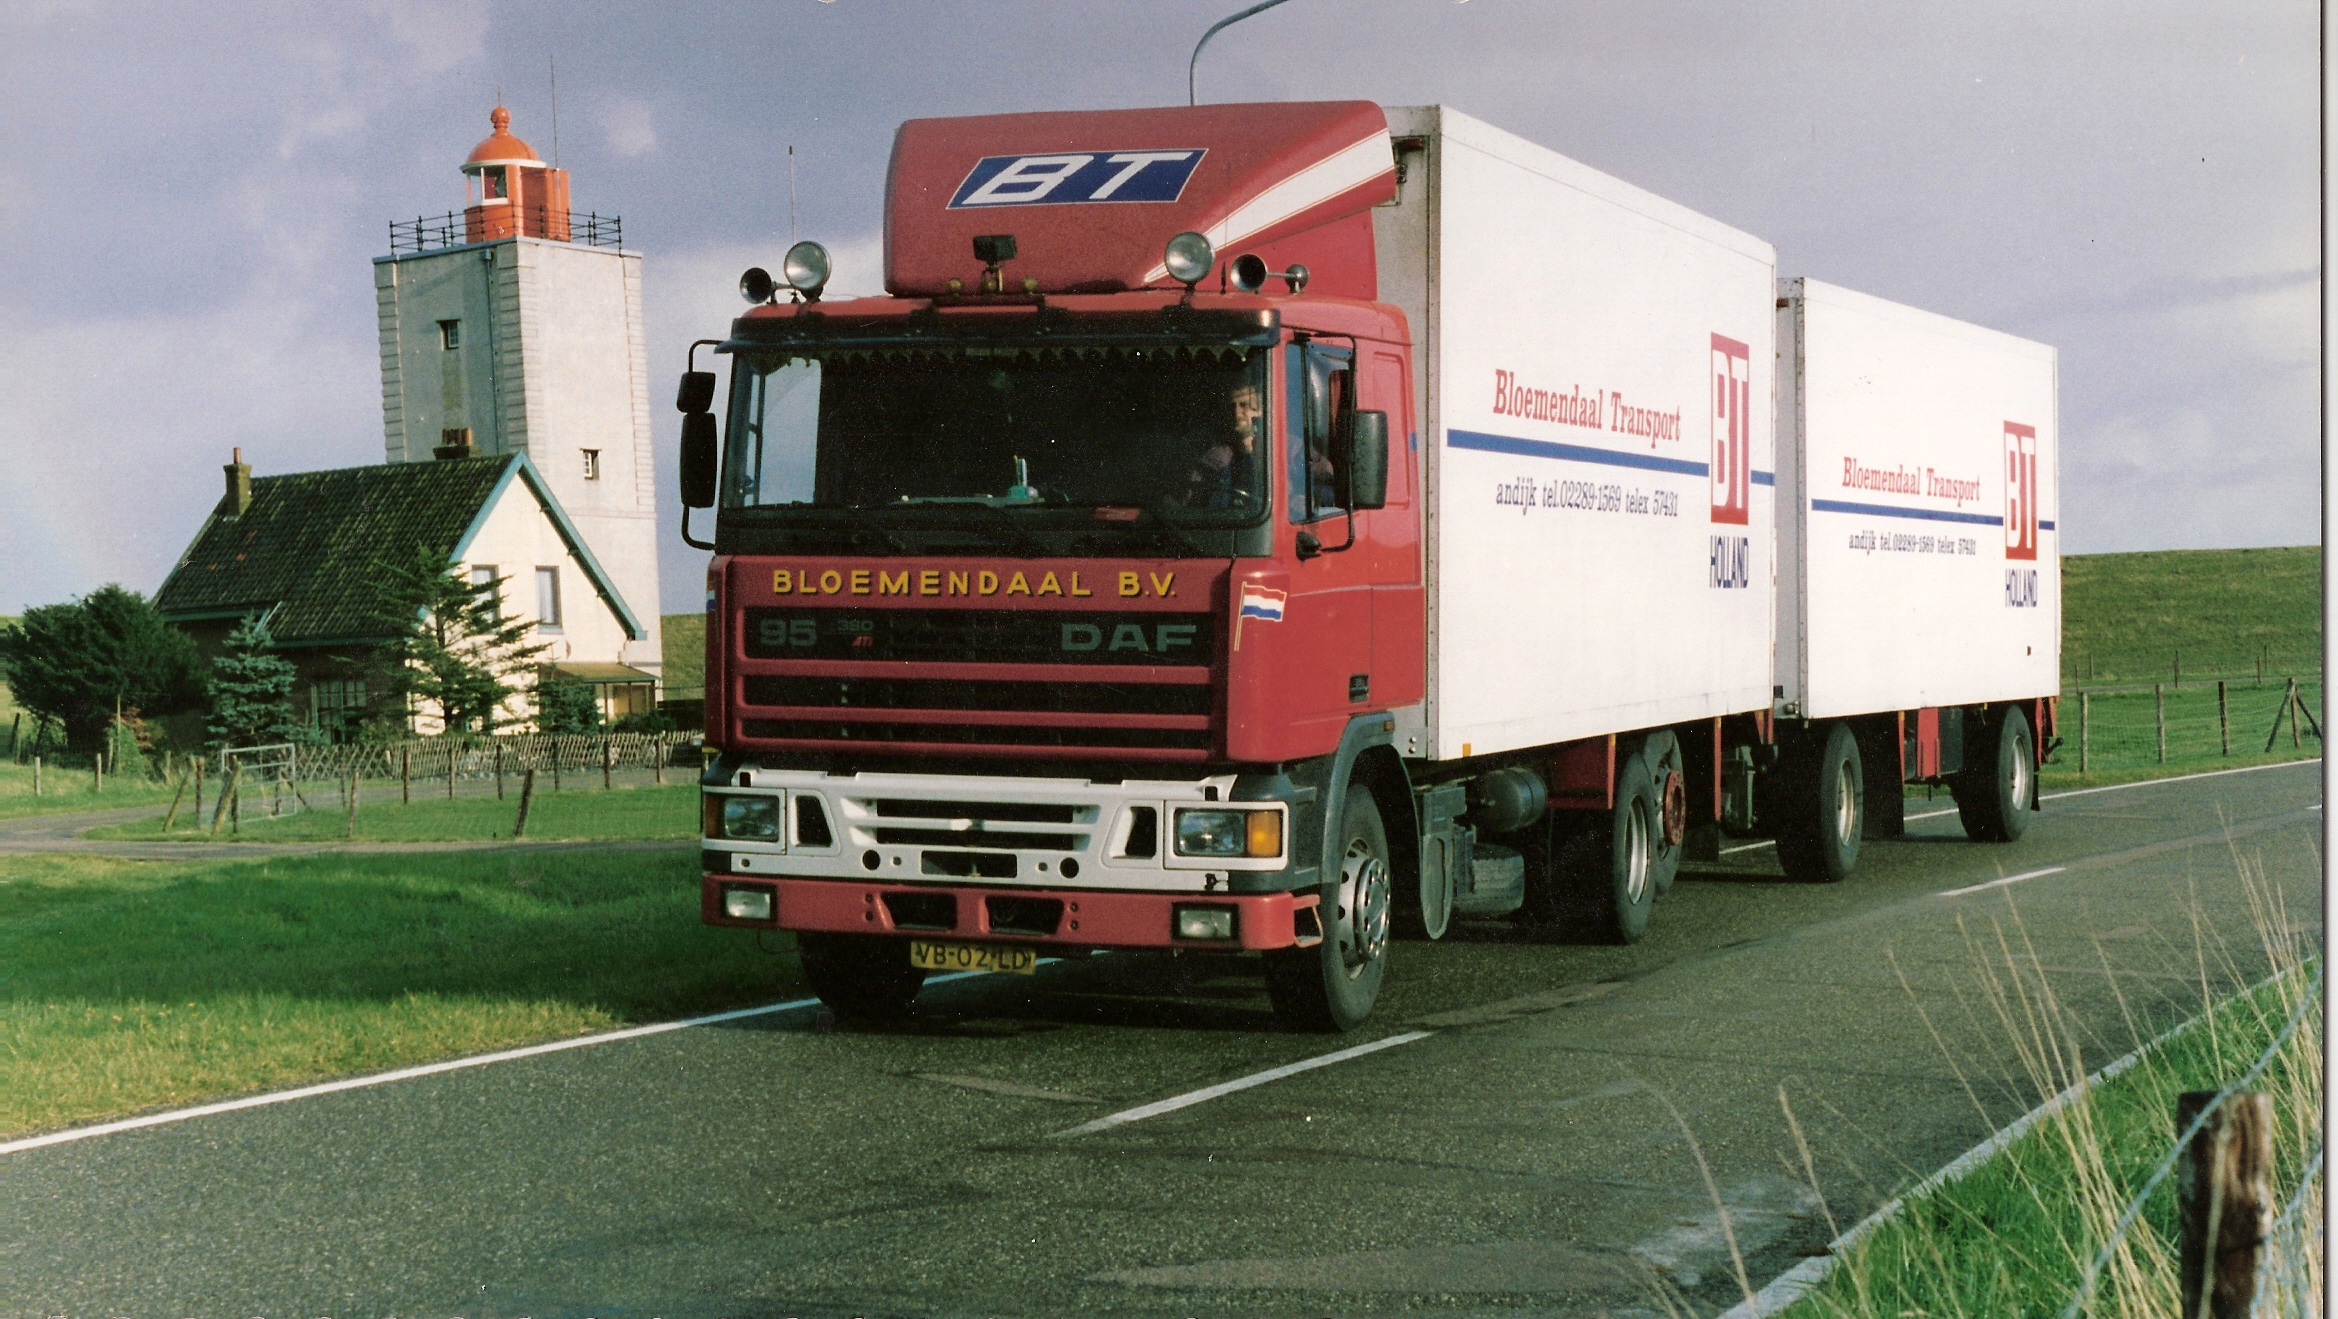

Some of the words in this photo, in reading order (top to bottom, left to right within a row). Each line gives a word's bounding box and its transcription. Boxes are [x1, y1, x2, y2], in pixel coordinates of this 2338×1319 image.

[961, 151, 1193, 205] BT
[1493, 369, 1603, 430] Bloemendaal
[1611, 391, 1681, 449] Transport
[1712, 349, 1748, 509] BT
[1496, 477, 1537, 516] andijk
[1626, 487, 1649, 514] telex
[1652, 489, 1679, 517] 57431
[1842, 456, 1921, 496] Bloemendaal
[1927, 468, 1980, 508] Transport
[2005, 433, 2036, 549] BT
[1710, 535, 1749, 589] HOLLAND
[1849, 530, 1876, 556] andijk
[1937, 536, 1955, 554] telex
[1958, 538, 1976, 555] 57431
[772, 569, 1093, 598] BLOEMENDAAL
[1118, 571, 1178, 597] B.V.
[2005, 568, 2038, 608] HOLLAND
[759, 619, 818, 647] 95
[1061, 623, 1197, 652] DAF
